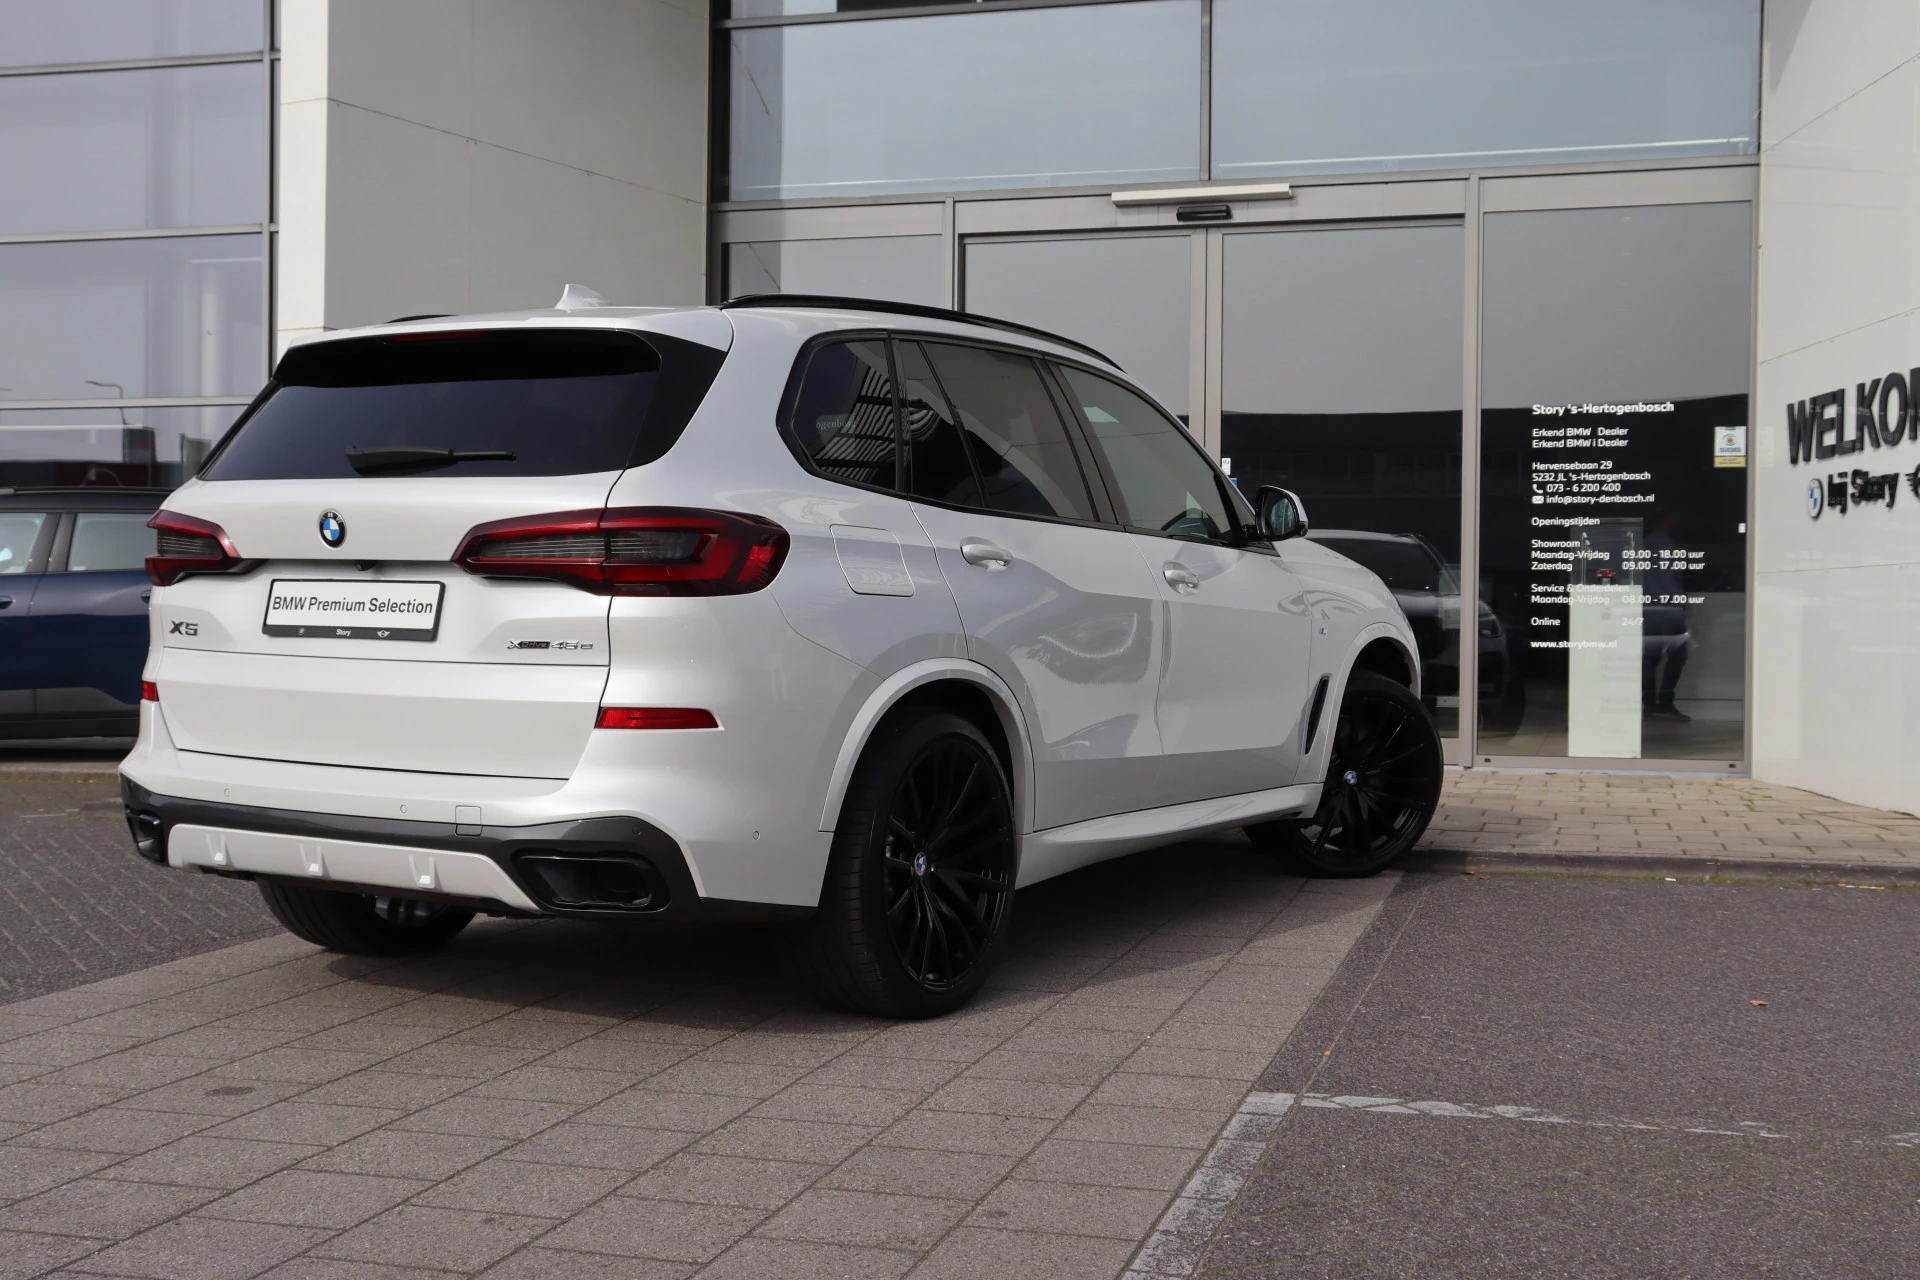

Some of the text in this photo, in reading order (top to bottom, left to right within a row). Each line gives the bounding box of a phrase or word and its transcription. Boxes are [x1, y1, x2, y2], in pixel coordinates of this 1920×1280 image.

[1532, 404, 1565, 416] Story
[1532, 427, 1629, 437] Erkend BMW Dealer
[1532, 438, 1629, 448] Erkend BMW i Dealer
[1532, 461, 1613, 470] Hervensebaan 29
[1532, 473, 1556, 481] 5232
[1557, 473, 1567, 481] JL
[1546, 484, 1564, 492] 073
[1572, 483, 1579, 492] 6
[1580, 483, 1600, 492] 200
[1601, 483, 1621, 492] 400
[1850, 469, 1900, 509] Story
[1546, 494, 1655, 504] info@story-denbosch.nl
[1531, 517, 1600, 527] Openingstijden
[1531, 539, 1580, 548] Showroom
[1531, 551, 1610, 560] Maandag-Vrijdag
[1622, 550, 1651, 559] 09.00
[1659, 550, 1686, 558] 18.00
[1531, 562, 1573, 571] Zaterdag
[1622, 561, 1651, 570] 09.00
[1688, 562, 1705, 570] uur
[1531, 584, 1629, 592] Service & Onderdelen
[272, 596, 433, 614] BMW Premium Selection
[1531, 595, 1610, 605] Maandag-Vrijdag
[1688, 596, 1705, 604] uur
[1531, 617, 1644, 626] Online 24/7
[169, 620, 198, 636] X5
[336, 628, 351, 637] Story
[1530, 640, 1618, 649] www.storybmw.nl
